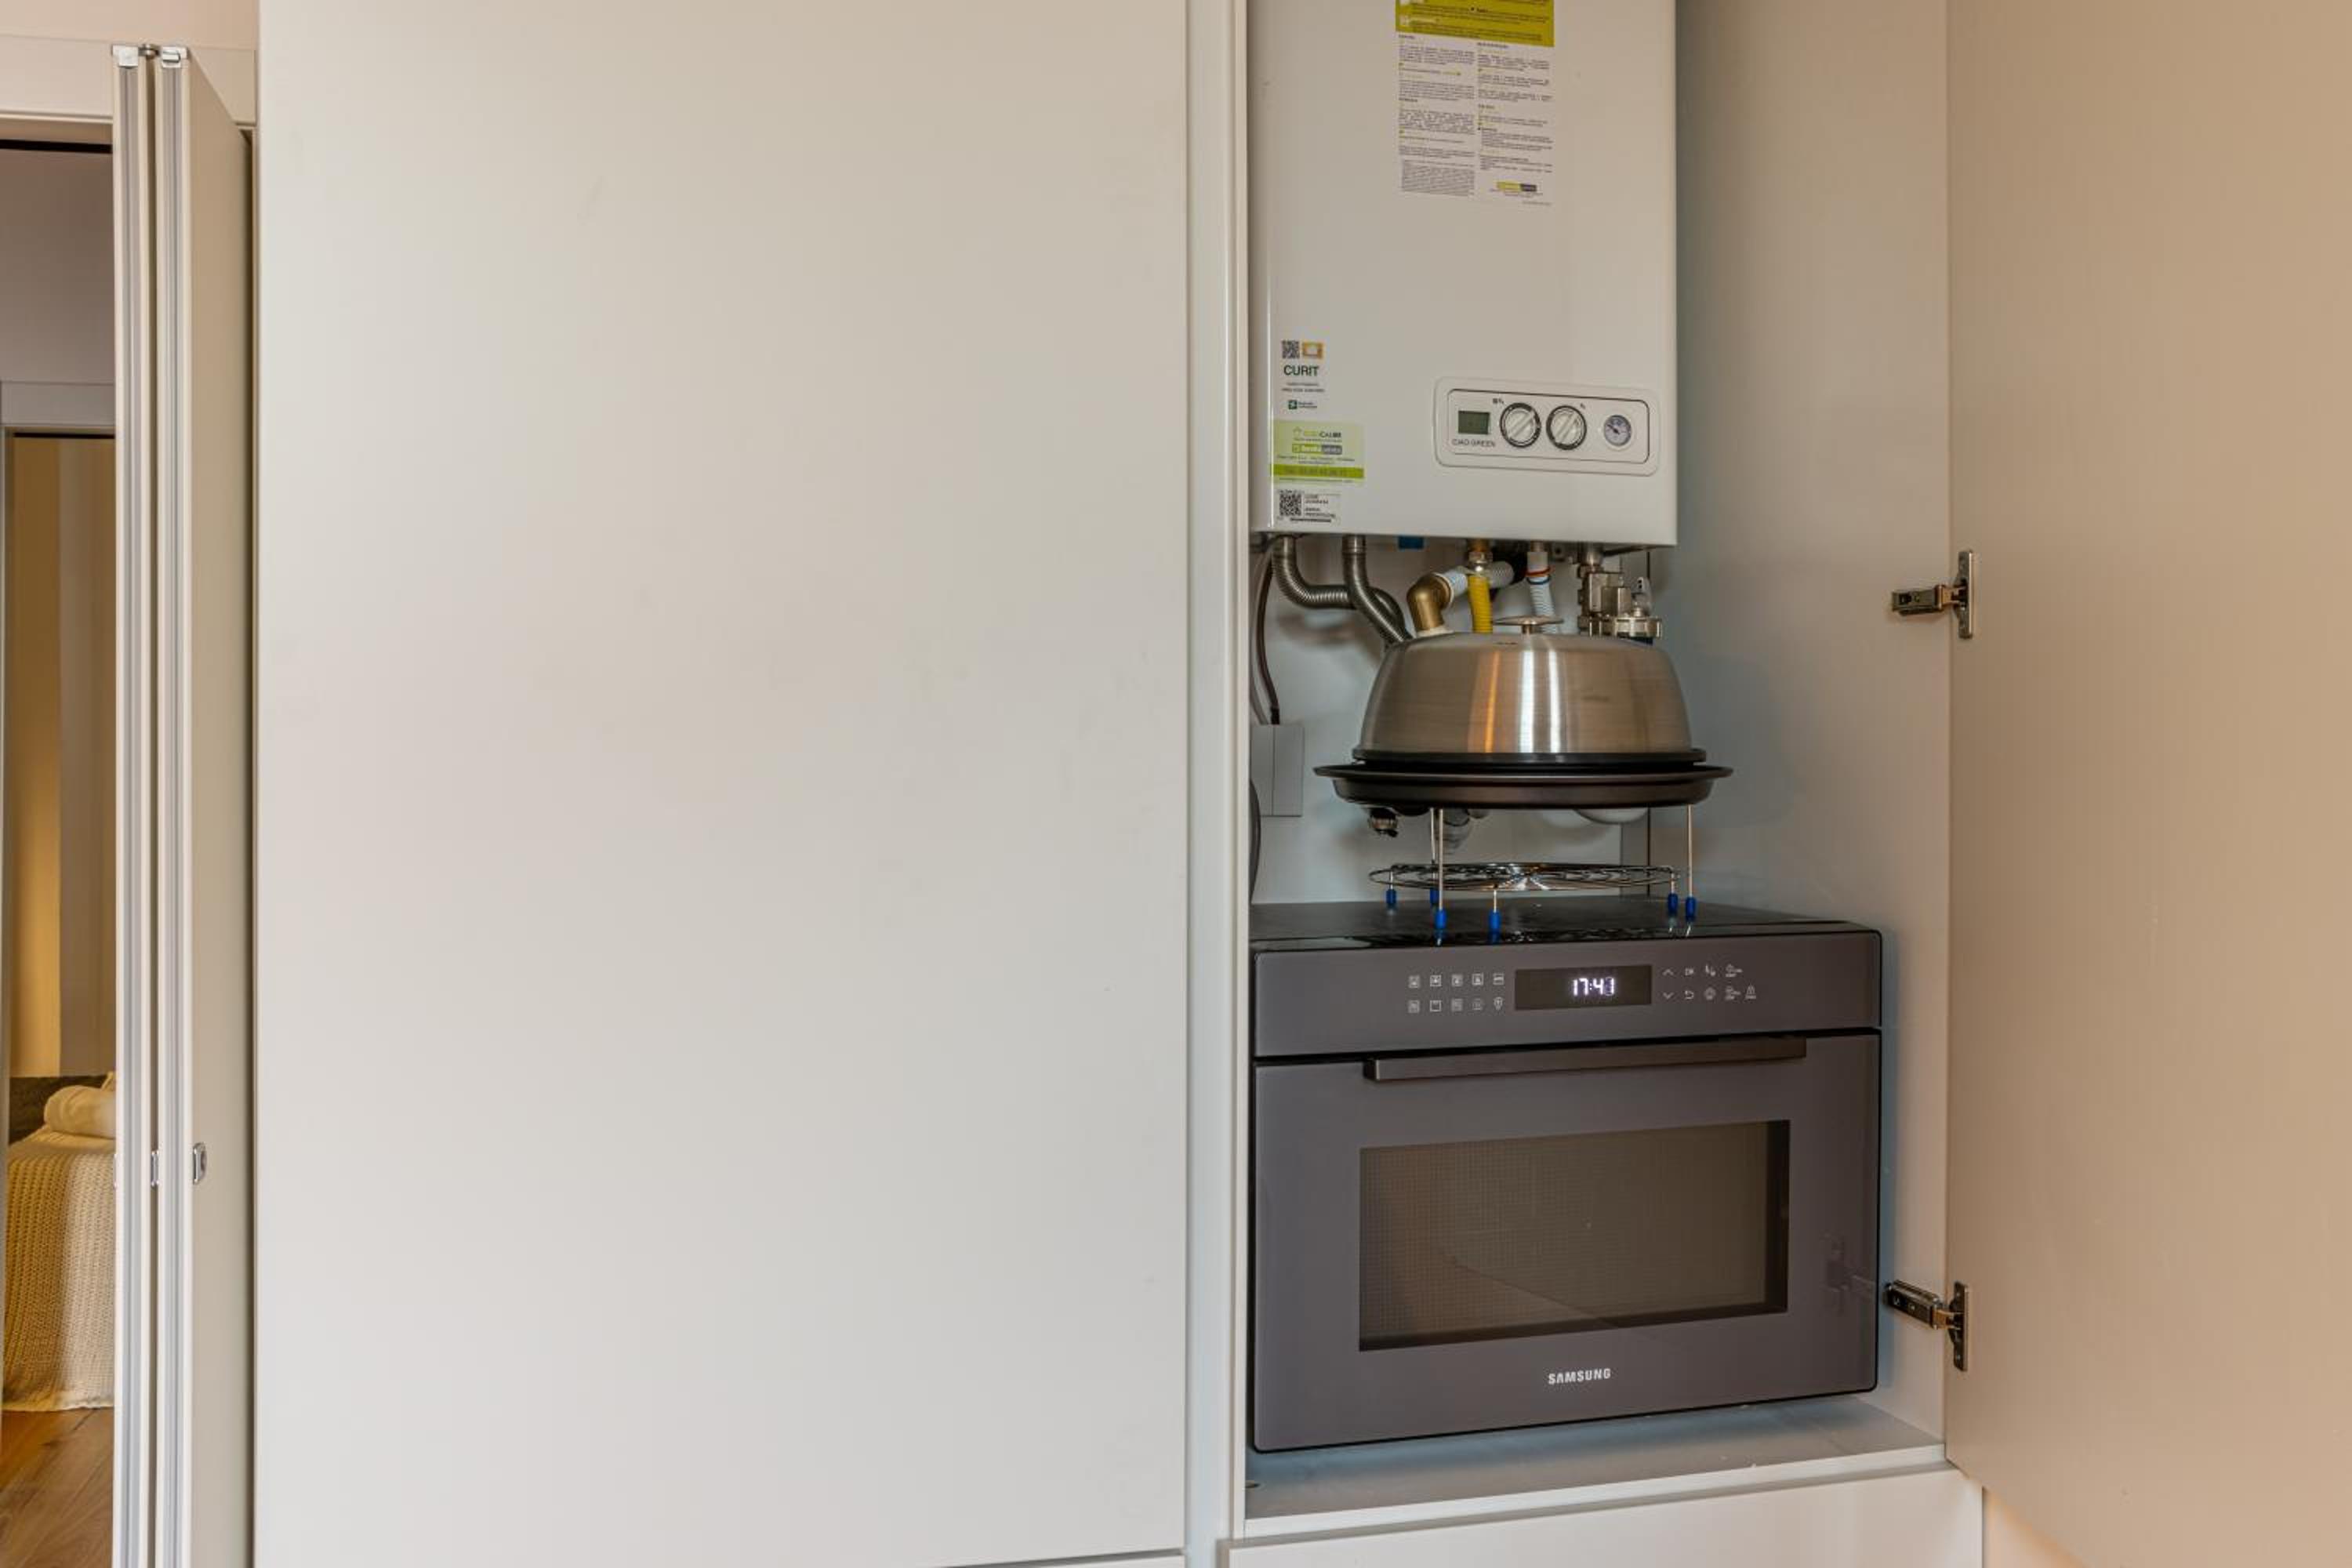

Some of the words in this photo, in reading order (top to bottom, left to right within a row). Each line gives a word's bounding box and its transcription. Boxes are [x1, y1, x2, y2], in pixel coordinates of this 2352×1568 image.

[1283, 365, 1319, 376] CURIT
[1471, 438, 1496, 448] GREEN
[1573, 977, 1614, 996] 17:41
[1548, 1368, 1611, 1385] SAMSUNG
